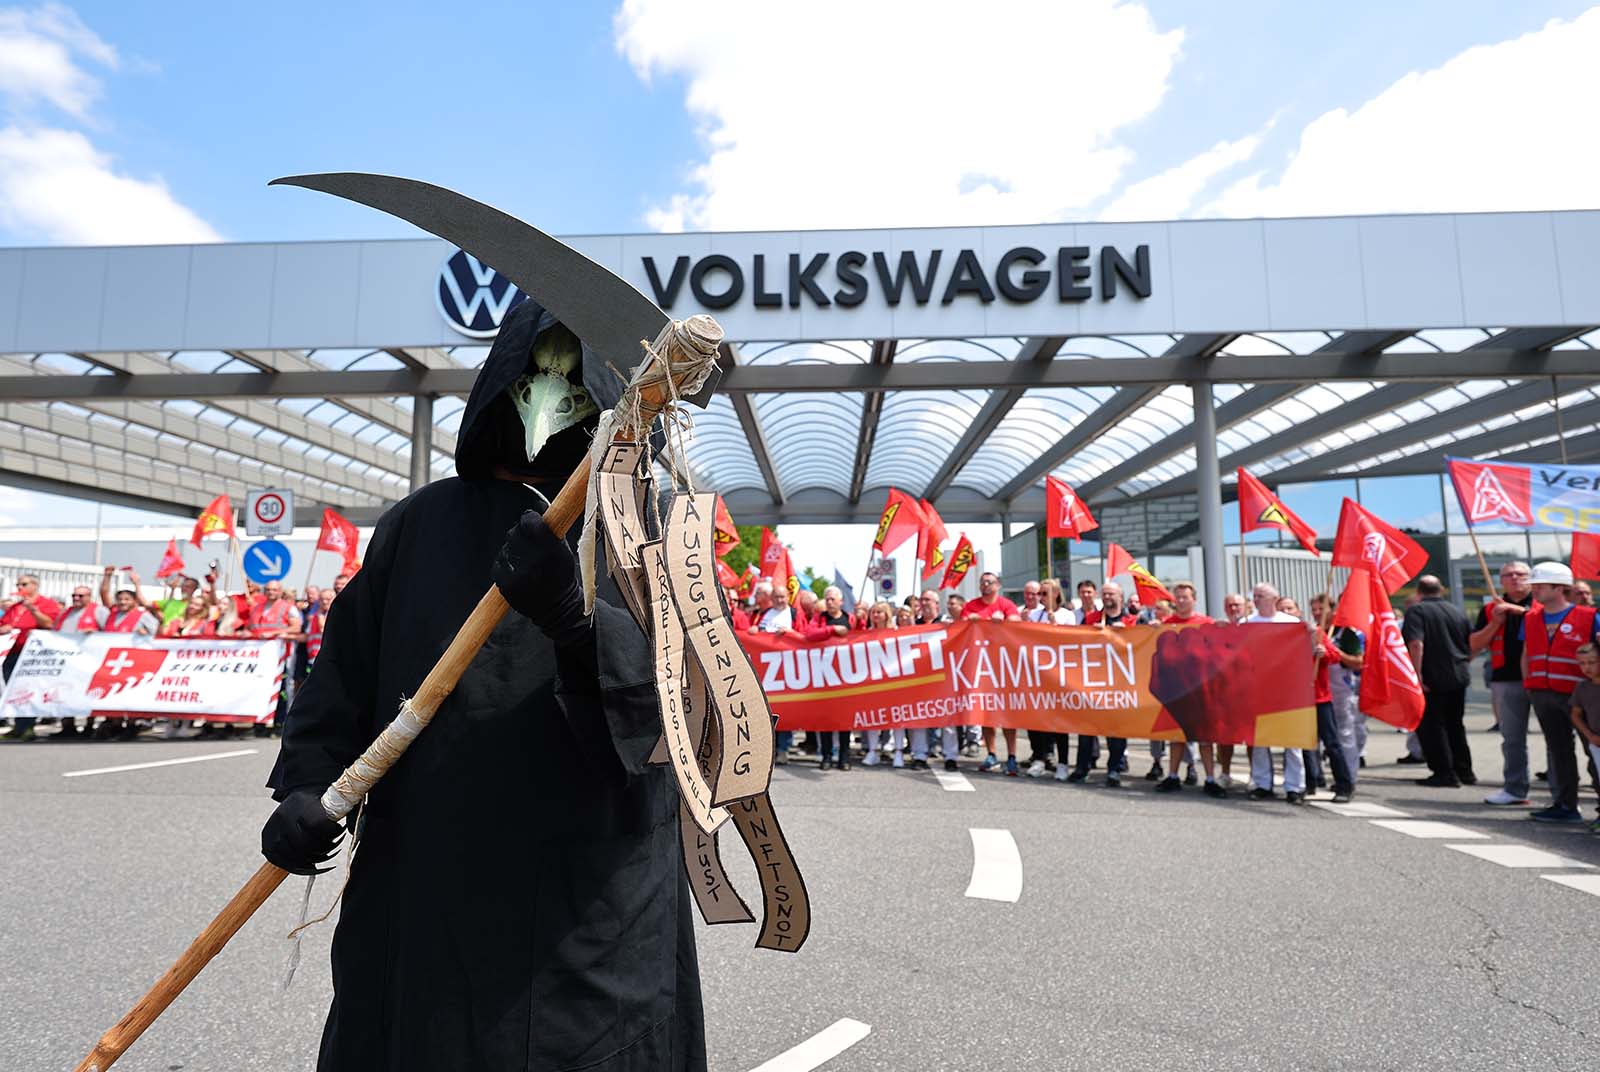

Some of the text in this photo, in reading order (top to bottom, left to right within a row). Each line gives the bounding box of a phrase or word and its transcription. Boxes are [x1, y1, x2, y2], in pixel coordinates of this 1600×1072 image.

[641, 244, 1152, 311] VOLKSWAGEN
[261, 502, 279, 516] 30
[683, 499, 752, 776] AUSGRENZUNG
[761, 630, 1136, 692] ZUKUNFT KÄMPFEN
[155, 690, 203, 703] MEHR.
[161, 676, 190, 687] WIR
[853, 690, 1138, 728] ALLE BELEGSCHAFTEN IM VW-KONZERN
